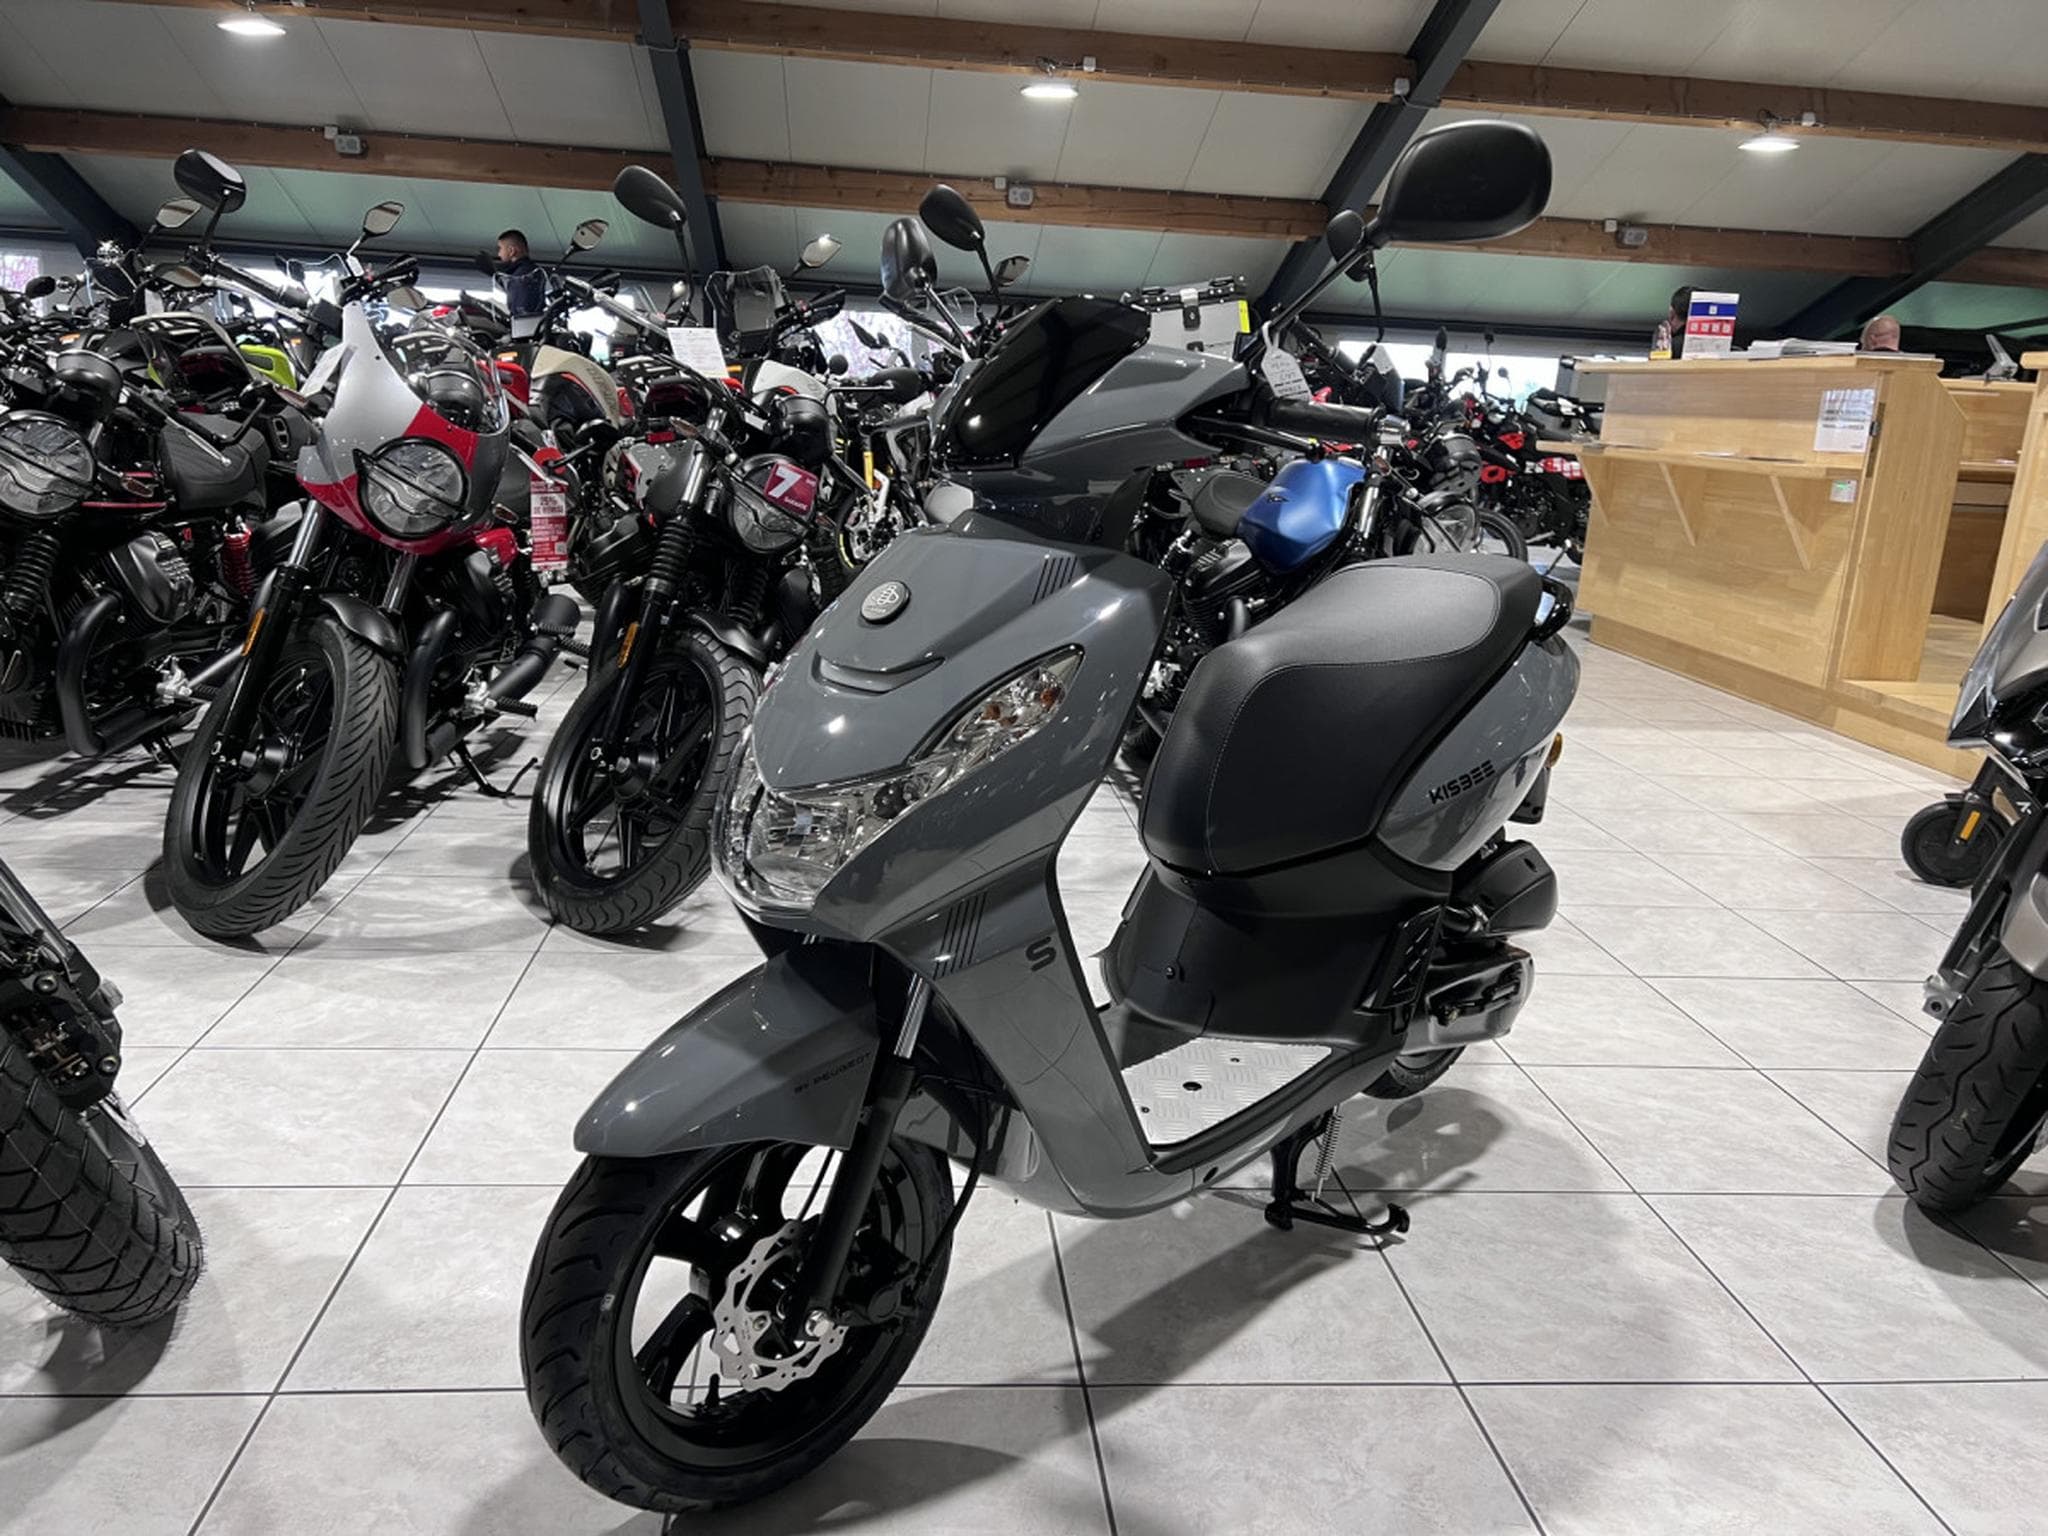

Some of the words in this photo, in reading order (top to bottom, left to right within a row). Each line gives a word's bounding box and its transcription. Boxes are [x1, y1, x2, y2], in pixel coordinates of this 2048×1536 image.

[768, 465, 802, 498] 7
[1429, 760, 1496, 804] KISBEE
[1026, 937, 1057, 971] S
[813, 1049, 871, 1085] PEUGEOT
